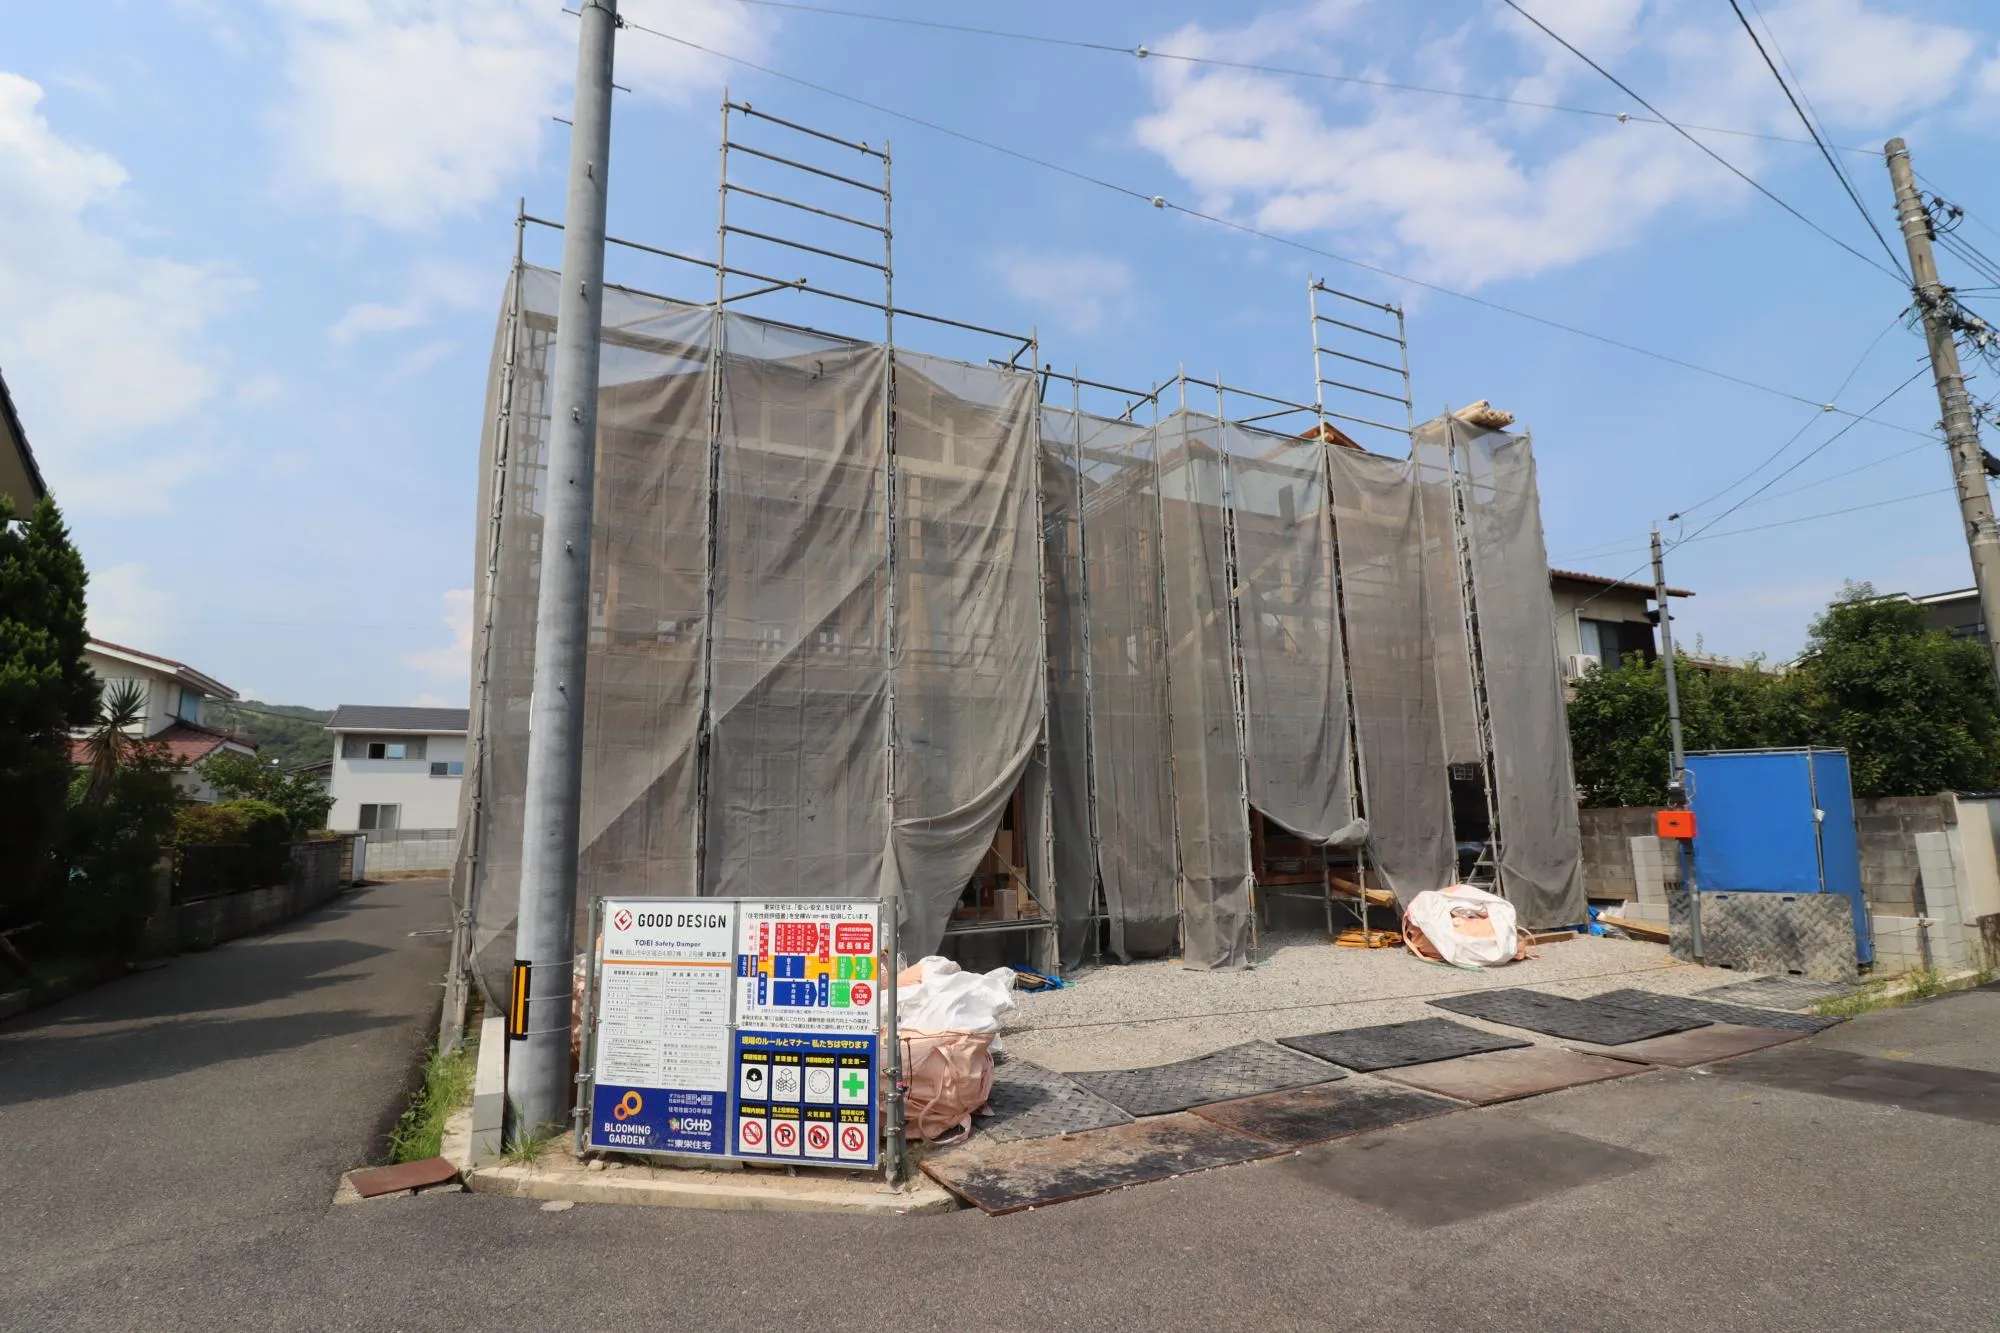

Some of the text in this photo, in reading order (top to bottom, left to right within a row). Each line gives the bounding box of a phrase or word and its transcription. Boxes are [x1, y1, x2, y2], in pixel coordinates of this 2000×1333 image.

[638, 914, 727, 928] GOOD DESIGN
[742, 1036, 869, 1049] 現場のルールとマナー 私たちは守ります
[604, 1122, 651, 1135] BLOOMING
[608, 1134, 645, 1145] GARDEN
[674, 1139, 711, 1150] 東栄住宅
